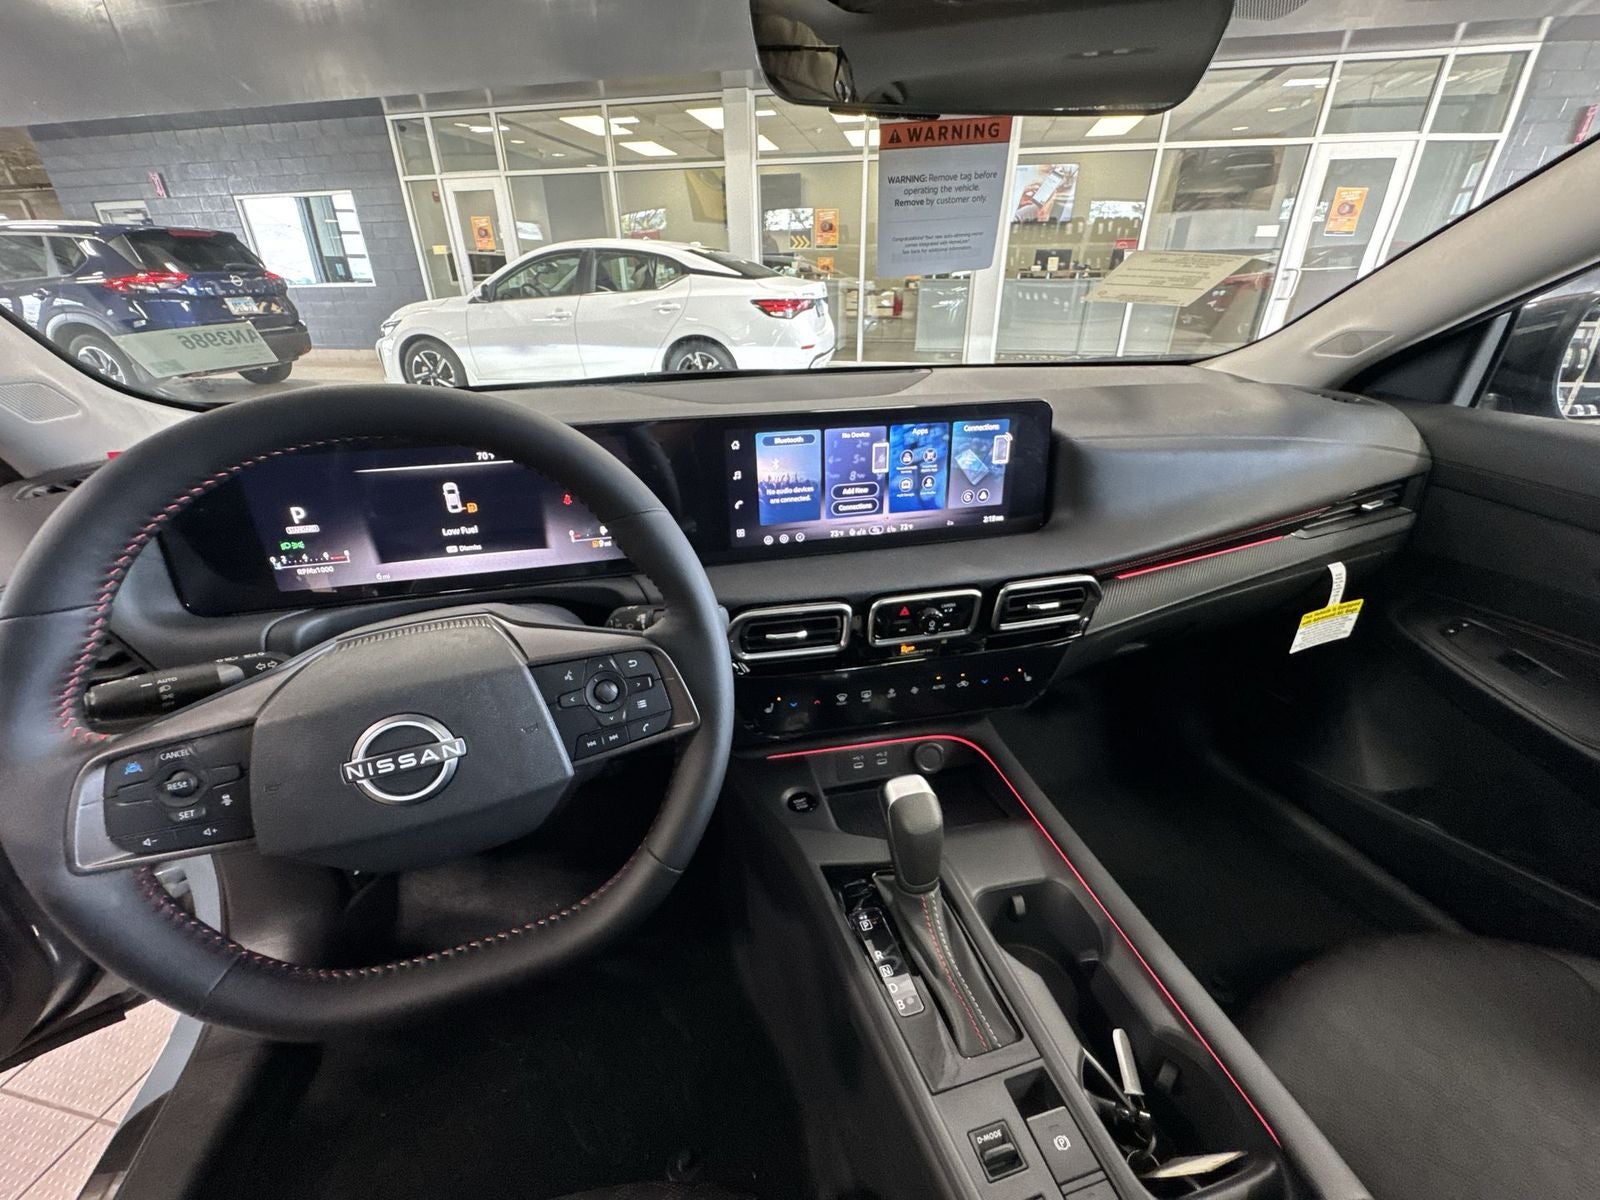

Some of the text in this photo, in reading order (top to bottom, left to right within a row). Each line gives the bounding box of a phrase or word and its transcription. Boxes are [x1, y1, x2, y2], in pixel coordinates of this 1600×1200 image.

[907, 123, 1000, 142] WARNING
[887, 170, 998, 184] WARNING: Remove tag before
[904, 185, 939, 196] operating
[940, 185, 952, 193] the
[894, 198, 925, 207] Remove
[926, 198, 935, 207] by
[936, 196, 970, 205] customer
[912, 428, 929, 436] Apps
[290, 506, 306, 524] P
[442, 525, 479, 536] Low Fuel
[156, 676, 178, 684] AUTO
[160, 749, 190, 760] CANCEL
[346, 741, 462, 780] NISSAN
[178, 809, 195, 820] SET
[874, 950, 884, 960] R
[889, 983, 898, 993] D
[896, 1000, 905, 1009] B
[976, 1129, 1002, 1144] D-MODE
